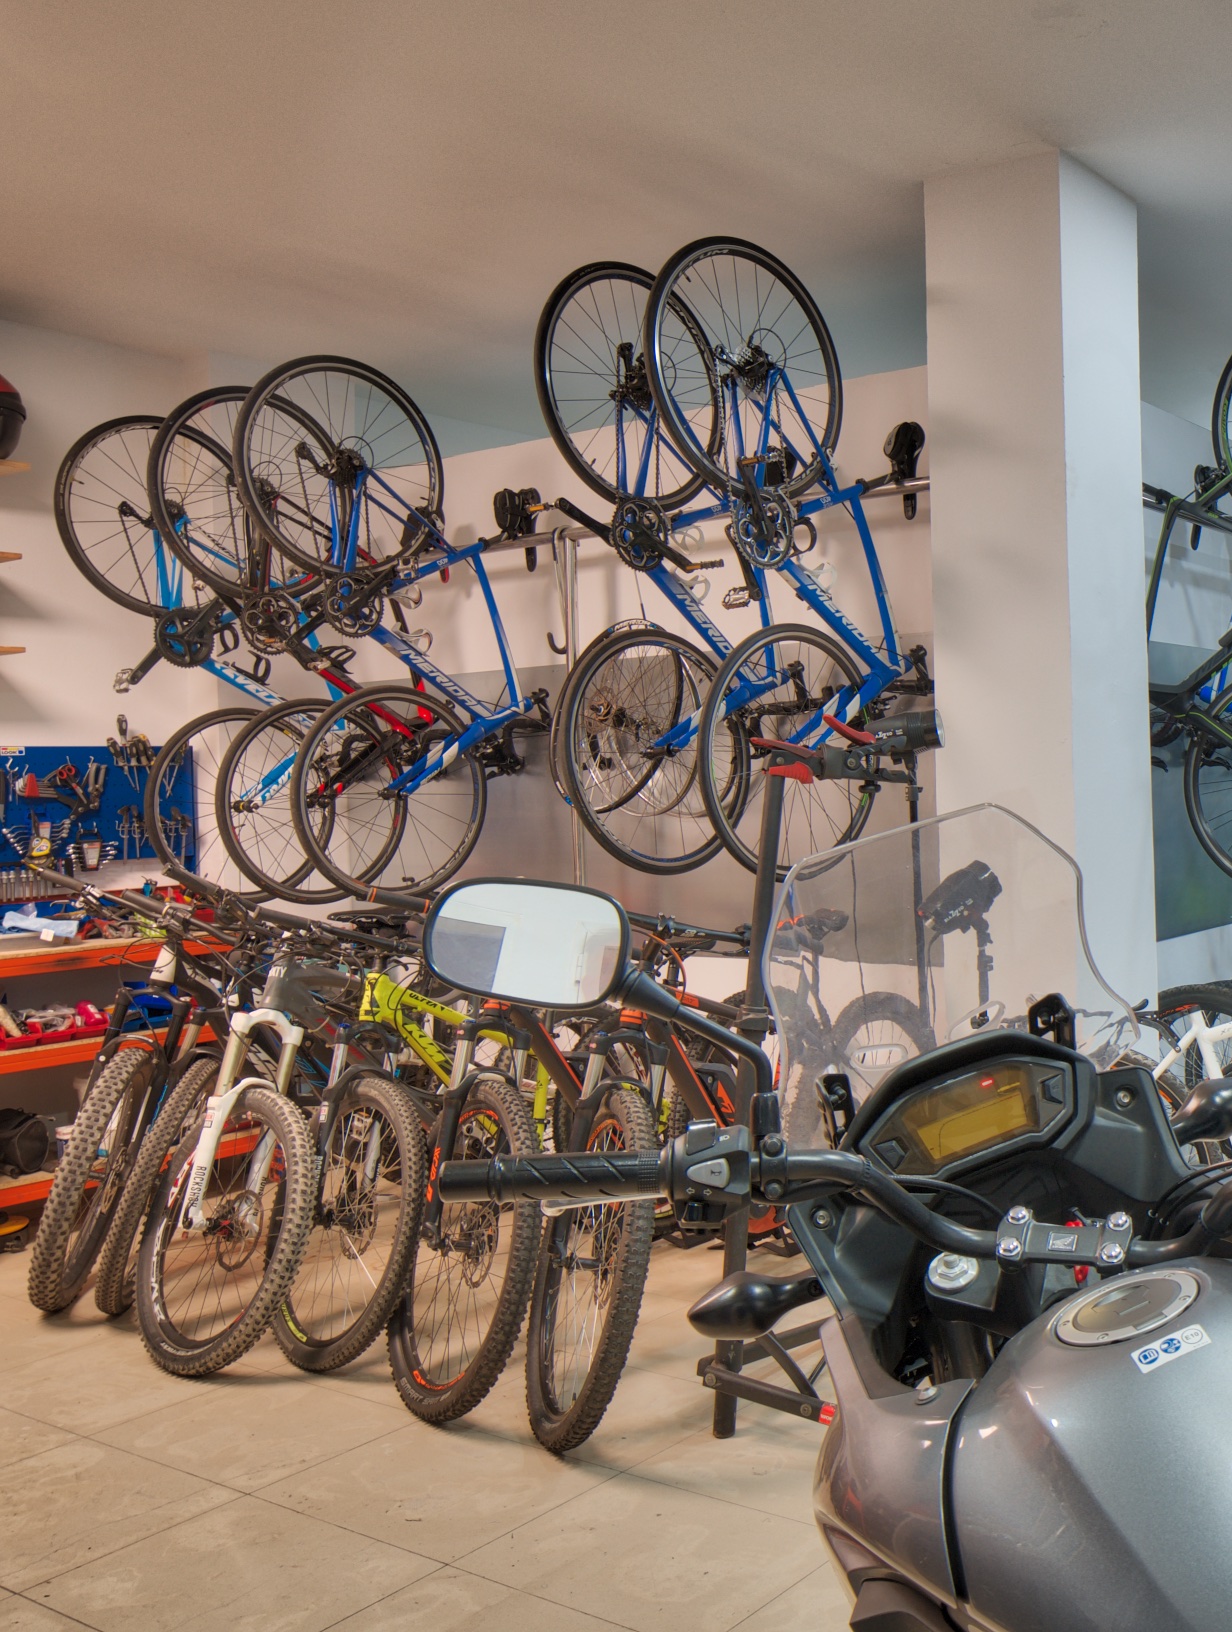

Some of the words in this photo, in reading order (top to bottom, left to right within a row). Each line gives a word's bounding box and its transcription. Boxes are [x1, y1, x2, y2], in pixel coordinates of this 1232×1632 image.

[676, 594, 735, 657] MERID
[807, 583, 881, 654] MERIDA
[400, 648, 480, 708] MERIDA
[1184, 1331, 1200, 1341] E10
